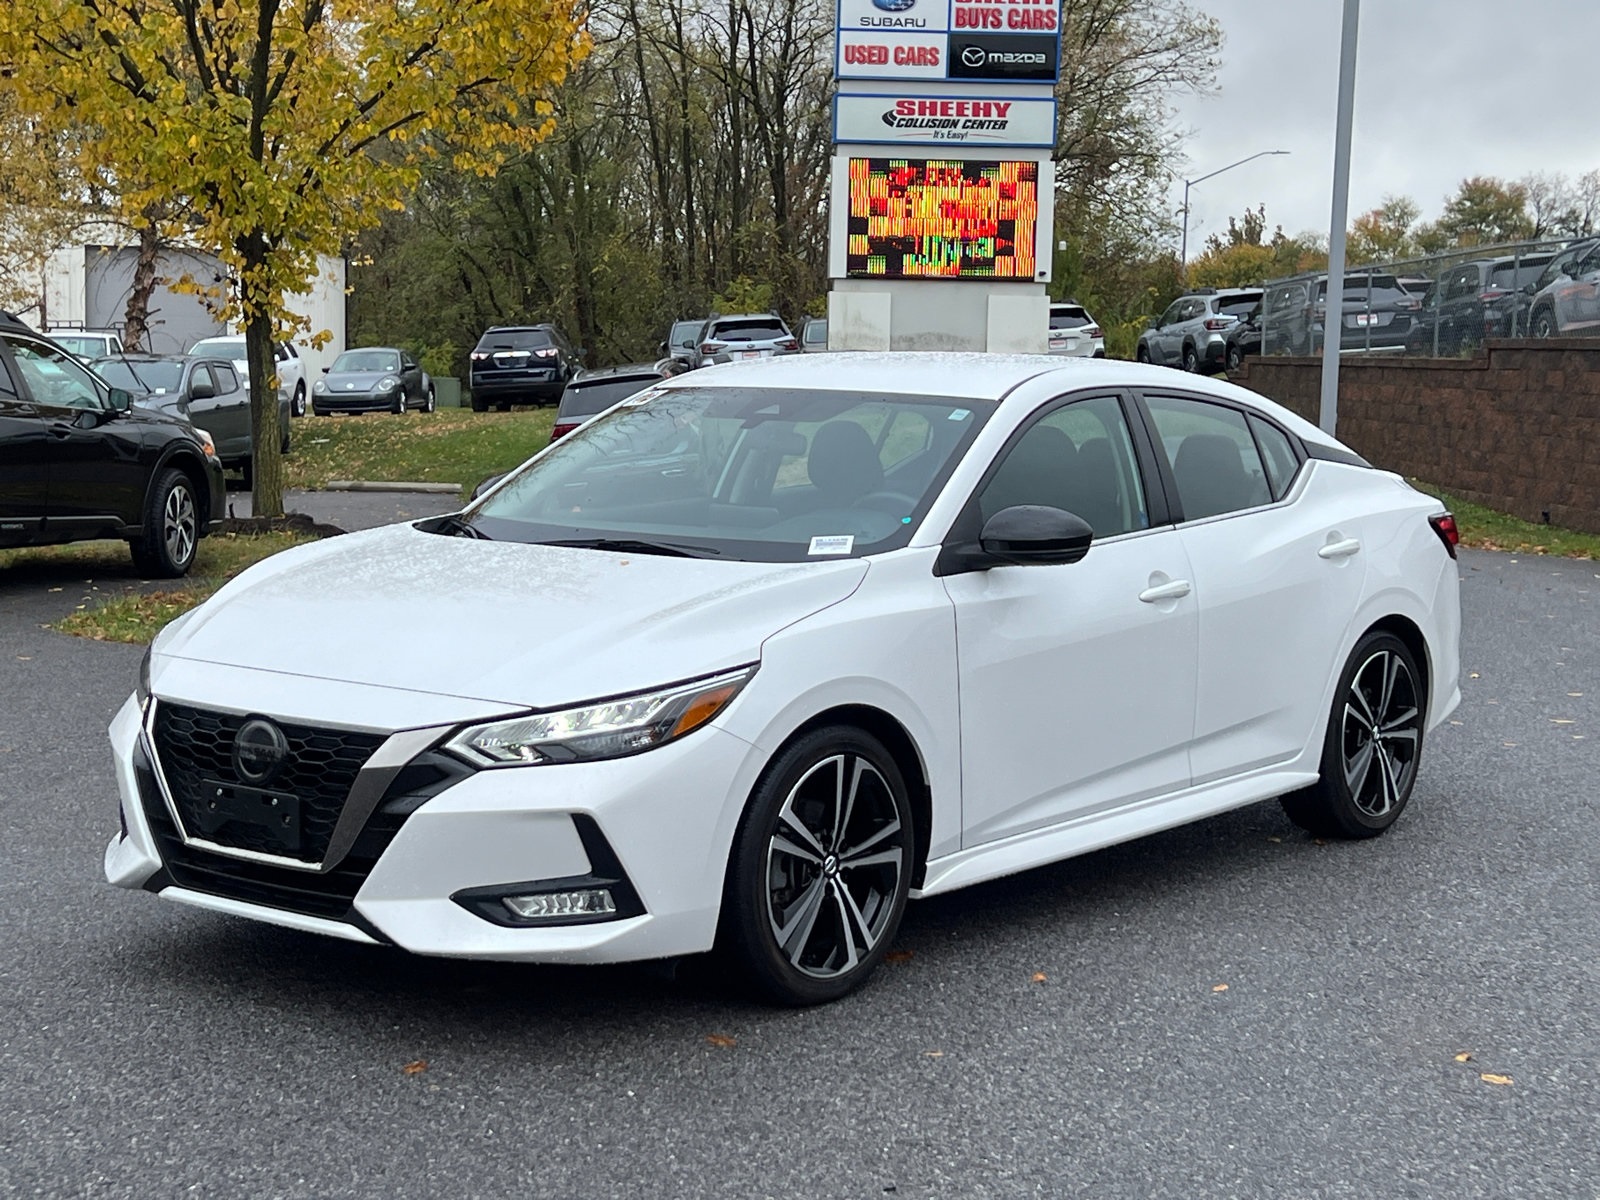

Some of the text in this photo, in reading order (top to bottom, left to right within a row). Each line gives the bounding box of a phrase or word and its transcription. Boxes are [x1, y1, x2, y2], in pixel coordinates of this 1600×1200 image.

[860, 16, 926, 28] SUBARU
[955, 7, 1057, 31] BUYS CARS
[844, 45, 940, 67] USED CARS
[895, 100, 1012, 118] SHEEHY
[895, 117, 1009, 130] COLLISION CENTER
[933, 130, 969, 141] It's Easy!
